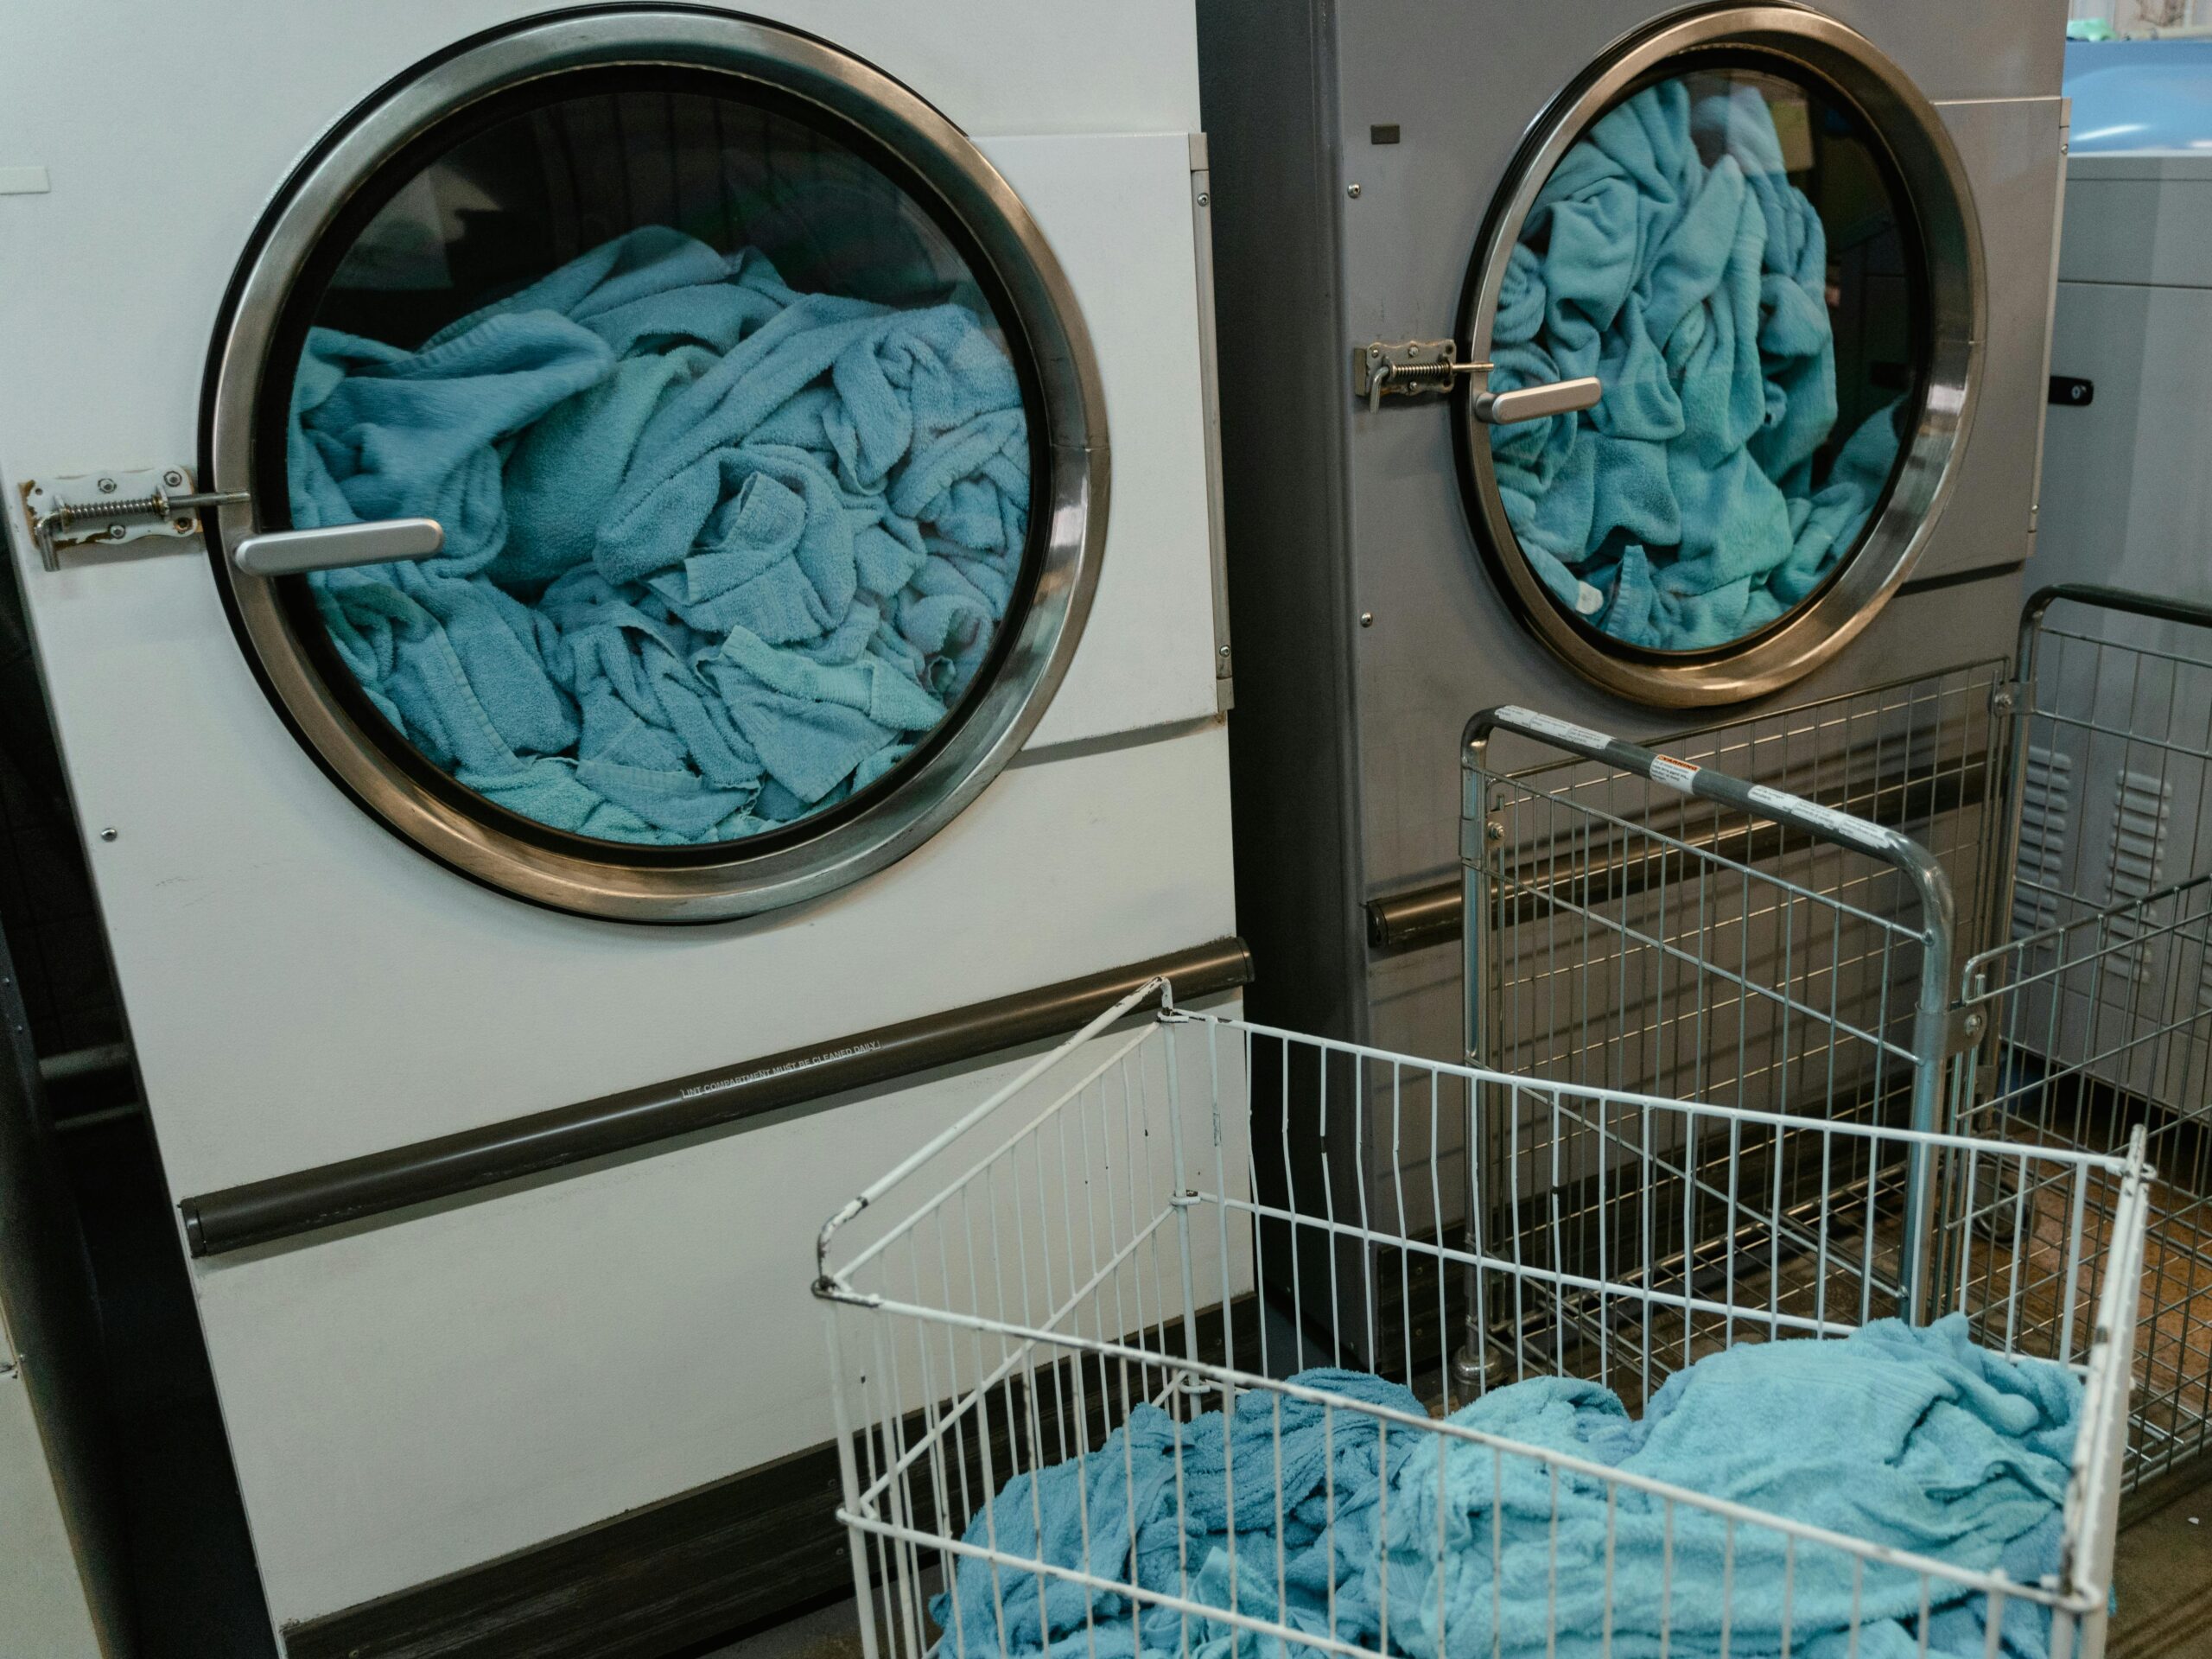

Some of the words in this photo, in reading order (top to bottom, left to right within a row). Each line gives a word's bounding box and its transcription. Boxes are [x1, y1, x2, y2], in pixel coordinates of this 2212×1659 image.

[680, 1085, 701, 1097] LINT
[704, 1070, 771, 1092] COMPARTMENT
[772, 1062, 797, 1075] MUST
[798, 1058, 810, 1069] BE
[812, 1048, 852, 1065] CLEANED
